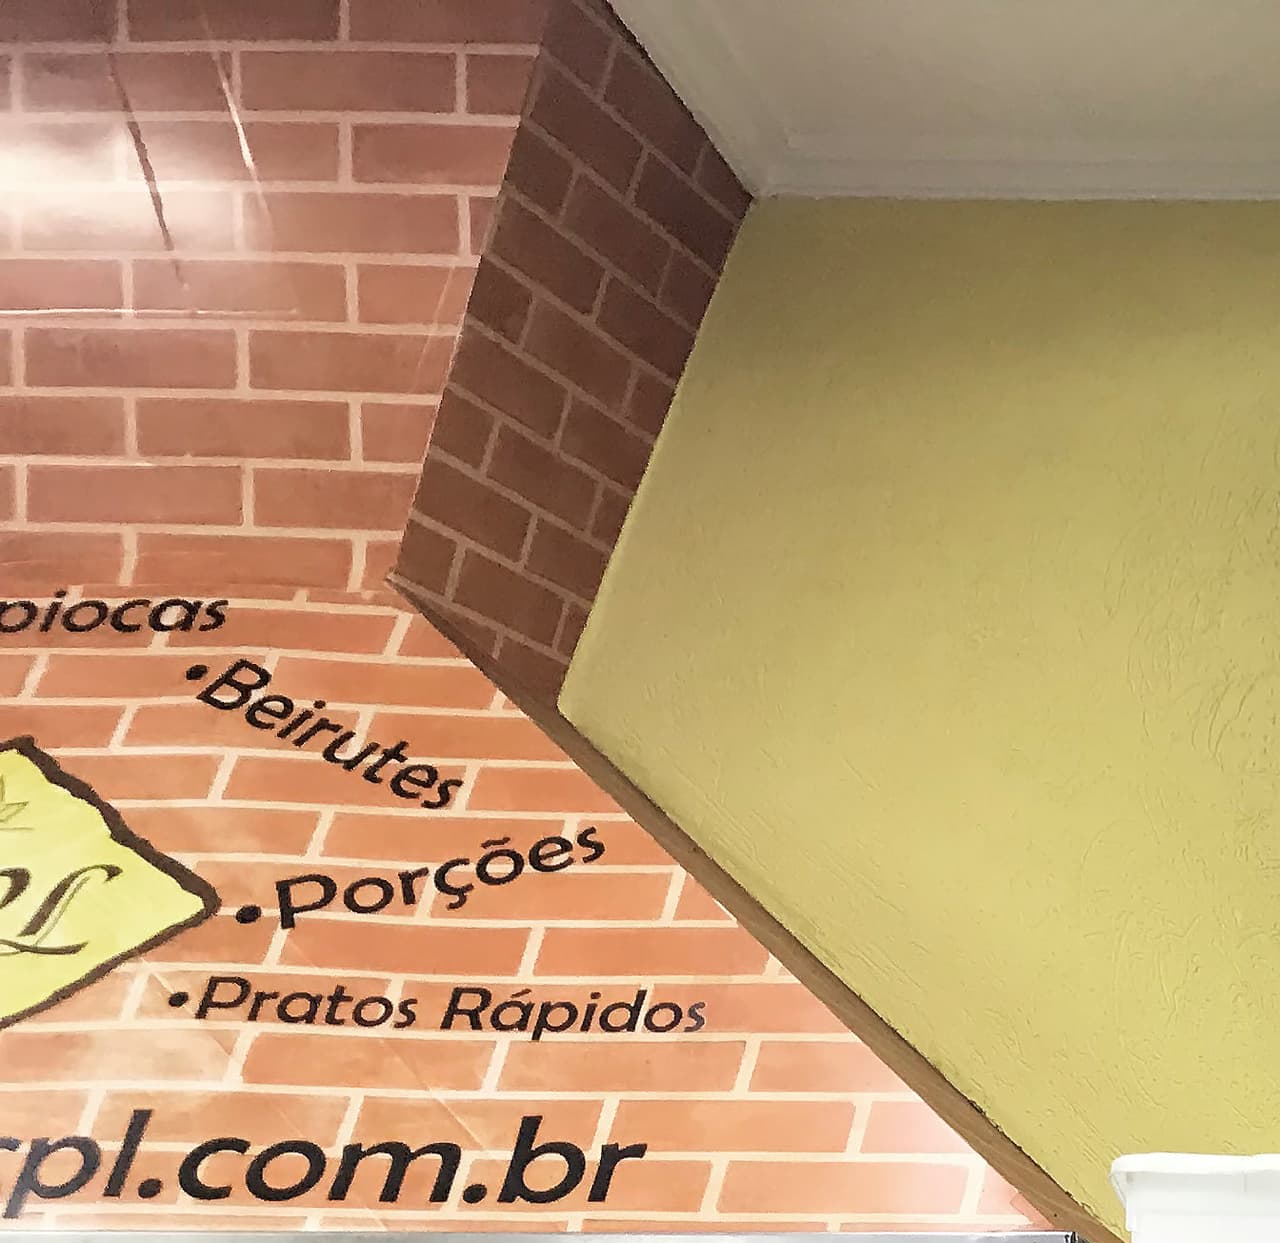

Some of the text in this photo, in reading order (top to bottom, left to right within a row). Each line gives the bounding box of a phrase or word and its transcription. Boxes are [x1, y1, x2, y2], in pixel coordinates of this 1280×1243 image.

[196, 657, 464, 811] Beirutes
[276, 823, 607, 930] Porções
[195, 975, 708, 1043] Pratos Rápidos
[0, 1108, 648, 1219] pl.com.br
